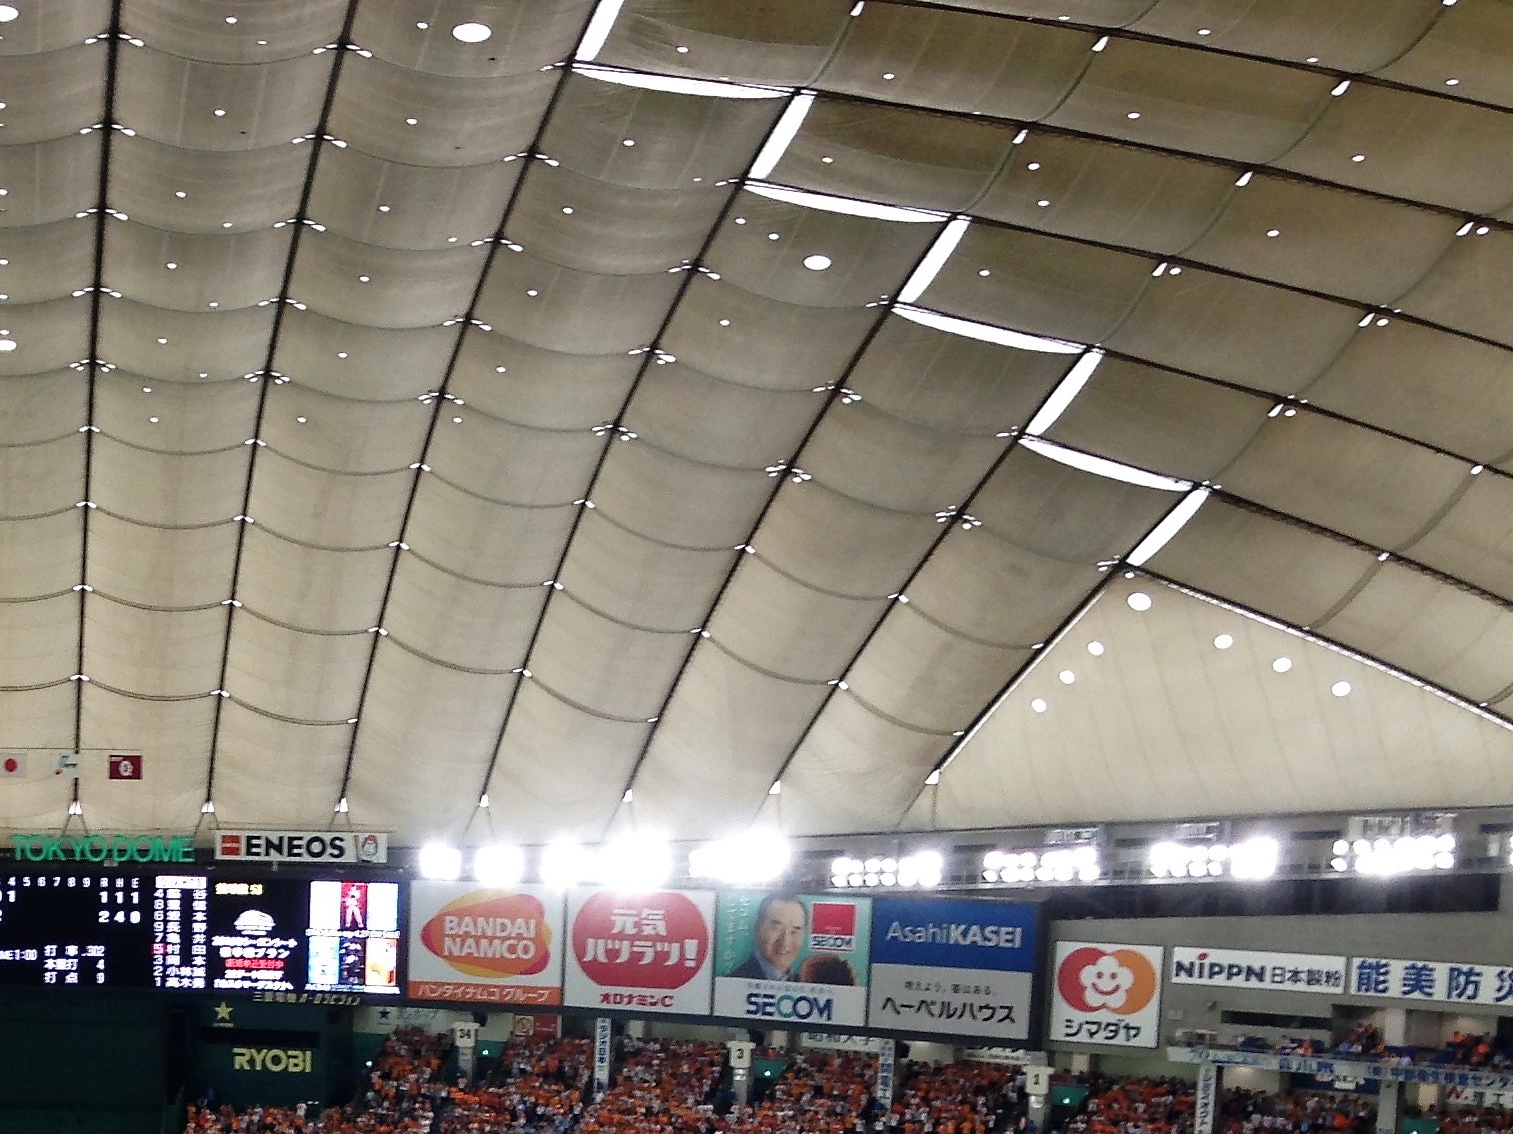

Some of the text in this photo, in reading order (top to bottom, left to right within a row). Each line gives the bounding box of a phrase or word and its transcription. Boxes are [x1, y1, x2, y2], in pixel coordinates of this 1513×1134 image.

[10, 834, 196, 862] TOKYO DOME
[245, 834, 346, 859] ENEOS
[7, 875, 17, 887] 4
[22, 876, 32, 888] 5
[37, 876, 47, 888] 6
[52, 876, 61, 888] 7
[67, 876, 77, 888] 8
[82, 876, 92, 889] 9
[7, 890, 16, 903] 1
[99, 891, 108, 904] 1
[115, 891, 124, 904] 1
[131, 891, 139, 904] 1
[153, 888, 164, 900] 4
[153, 899, 164, 911] 8
[98, 910, 110, 923] 2
[114, 910, 126, 923] 4
[130, 911, 141, 924] 0
[153, 911, 164, 921] 6
[611, 908, 668, 936] 元気
[153, 921, 164, 933] 9
[444, 914, 536, 937] BANDAI
[153, 932, 164, 944] 7
[811, 935, 853, 948] SECOM
[153, 943, 164, 955] 5
[443, 937, 536, 960] NAMCO
[583, 937, 699, 968] ハツラツ!
[153, 954, 164, 966] 3
[153, 965, 164, 977] 2
[1270, 965, 1341, 988] 日本製粉
[153, 976, 164, 989] 1
[1356, 959, 1513, 1003] 能美防災
[502, 987, 550, 1002] グループ
[600, 993, 674, 1009] オロナミンC
[746, 993, 834, 1021] SECOM
[882, 996, 1016, 1024] ヘーベルハウス
[1063, 1018, 1142, 1041] シマダヤ
[233, 1048, 312, 1073] RYOBI
[736, 1048, 744, 1059] 3
